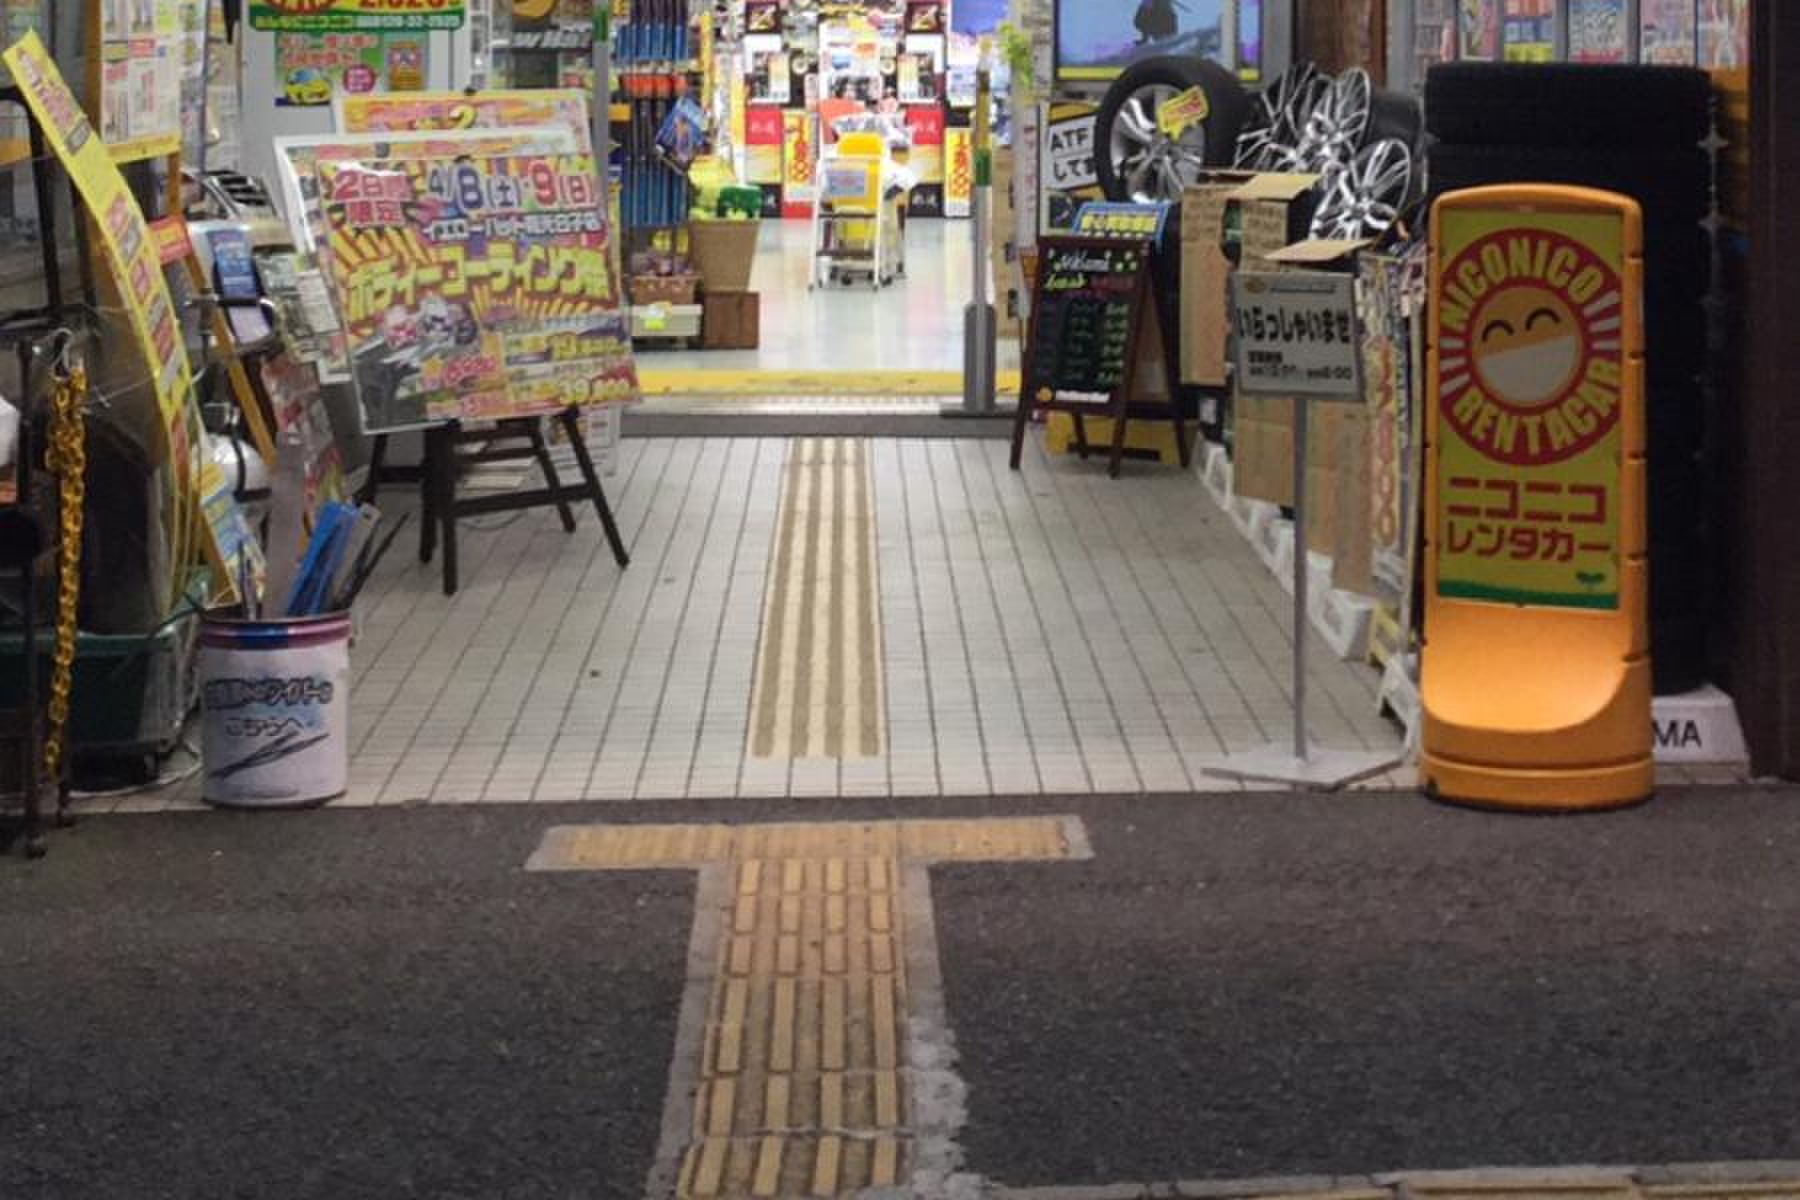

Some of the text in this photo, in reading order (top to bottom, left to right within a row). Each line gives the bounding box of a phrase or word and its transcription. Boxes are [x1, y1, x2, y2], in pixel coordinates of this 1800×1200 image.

[1051, 127, 1089, 152] ATF
[1440, 236, 1606, 332] NICONICO
[1236, 306, 1351, 345] いらっしゃいませ
[1452, 357, 1621, 456] RENTACAR
[1447, 476, 1607, 524] ニコニコ
[1447, 521, 1611, 563] レンタカー
